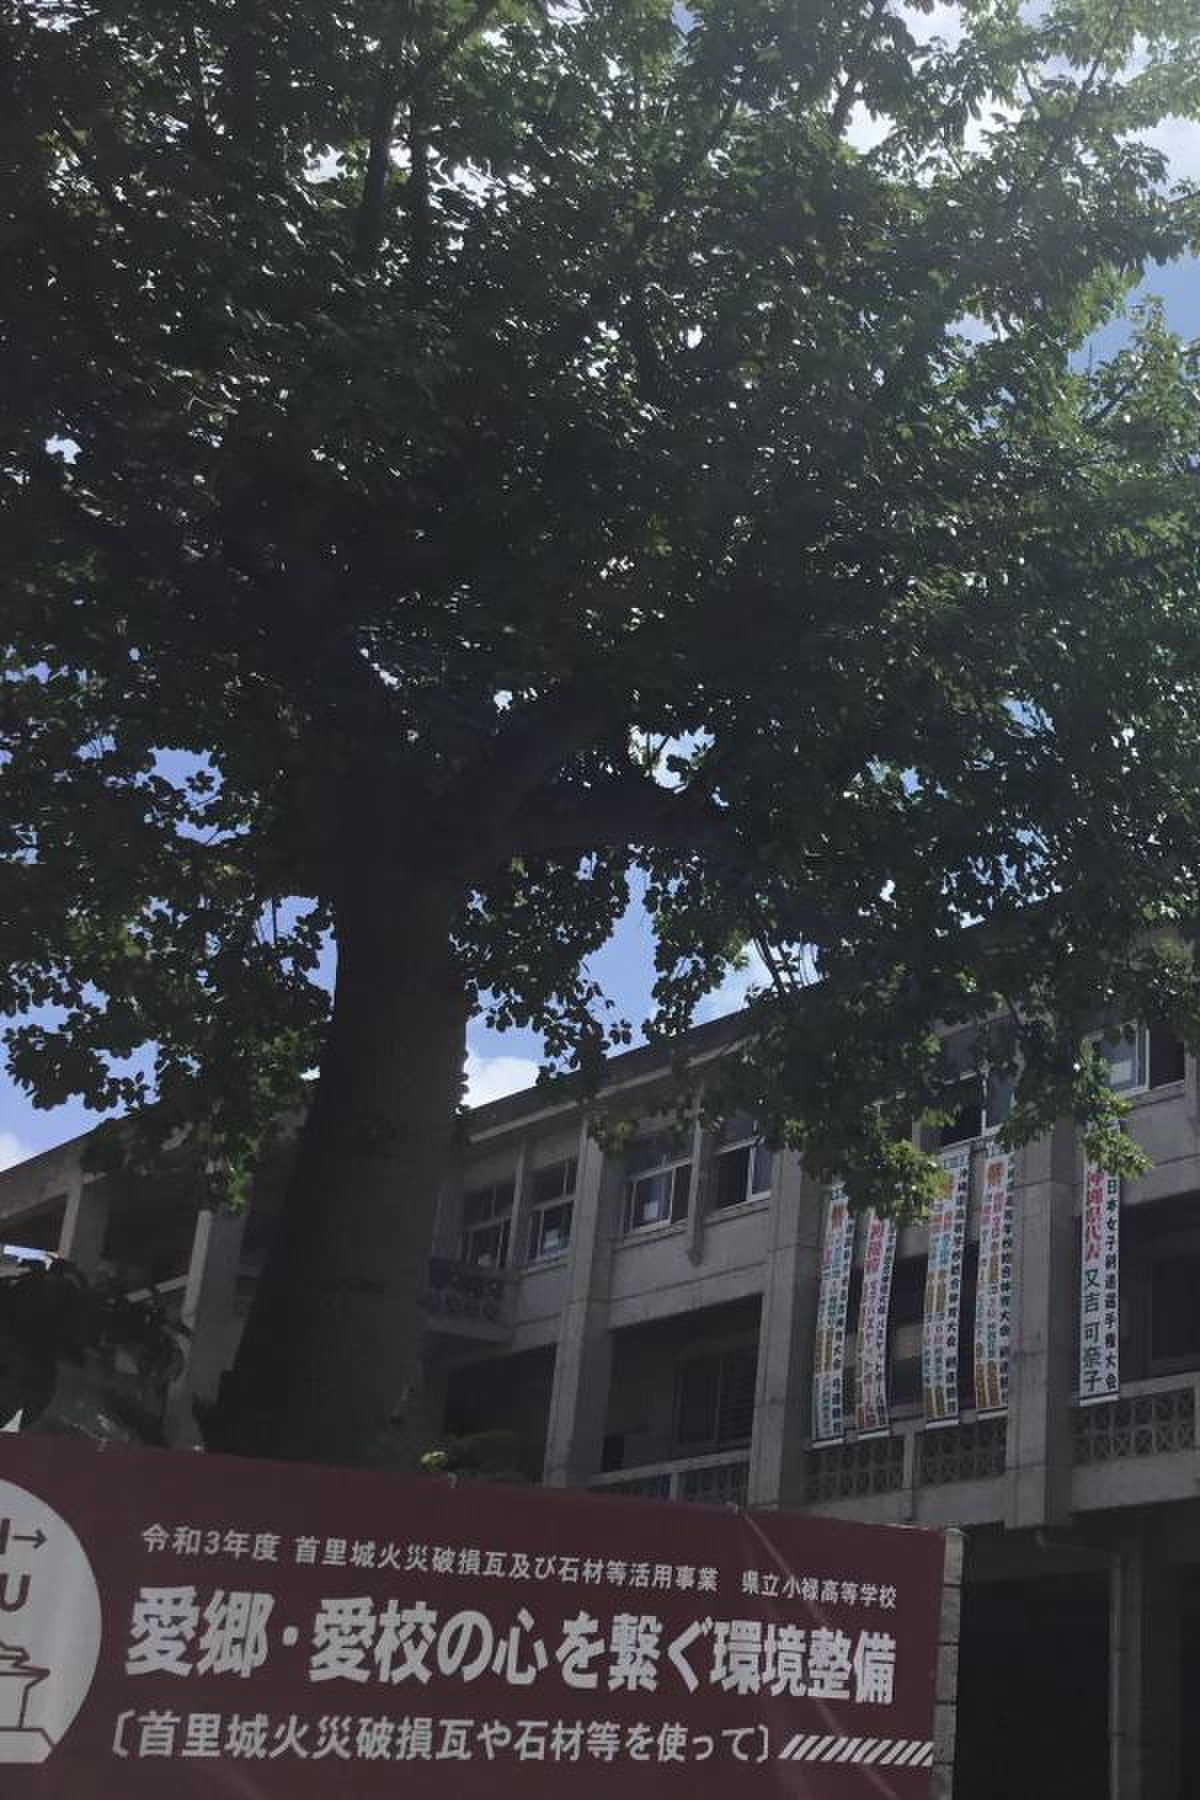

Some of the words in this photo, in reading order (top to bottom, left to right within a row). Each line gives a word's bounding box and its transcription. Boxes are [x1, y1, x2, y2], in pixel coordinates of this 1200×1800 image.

[1104, 1168, 1119, 1390] 日本女子剣道選手権大会
[141, 1523, 282, 1563] 令和3年度
[294, 1536, 720, 1593] 首里城火災破損瓦及び石材等活用事業
[740, 1569, 898, 1610] 県立小禄高等学校
[125, 1585, 897, 1705] 愛郷・愛校の心を繋ぐ環境整備
